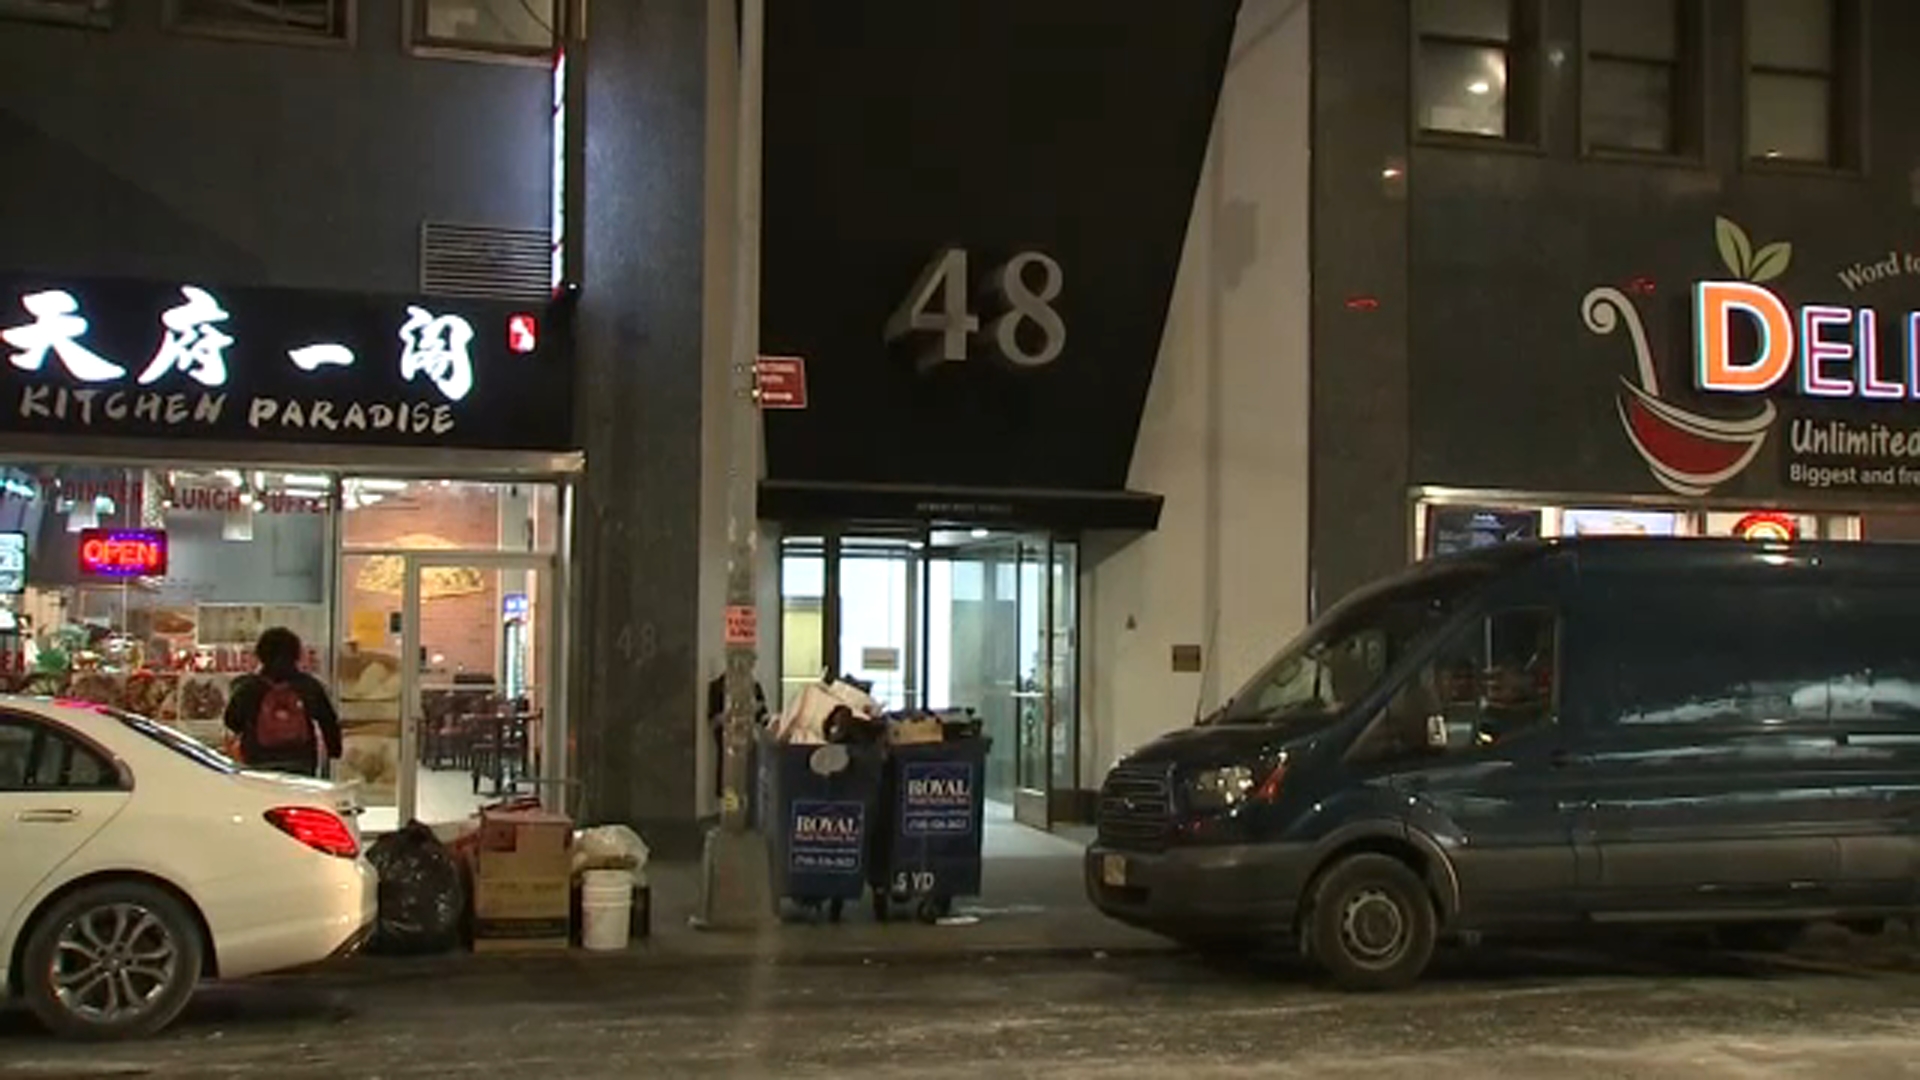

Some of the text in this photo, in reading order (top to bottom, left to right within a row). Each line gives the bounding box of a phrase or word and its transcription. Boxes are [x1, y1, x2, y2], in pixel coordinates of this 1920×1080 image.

[1839, 251, 1900, 293] Word
[908, 248, 1067, 366] 48
[19, 385, 455, 434] KITCHEN PARADISE
[1790, 463, 1858, 488] Biggest
[1860, 466, 1895, 484] and
[172, 487, 241, 513] LUNCH
[83, 540, 157, 567] OPEN
[907, 779, 970, 797] ROYAL
